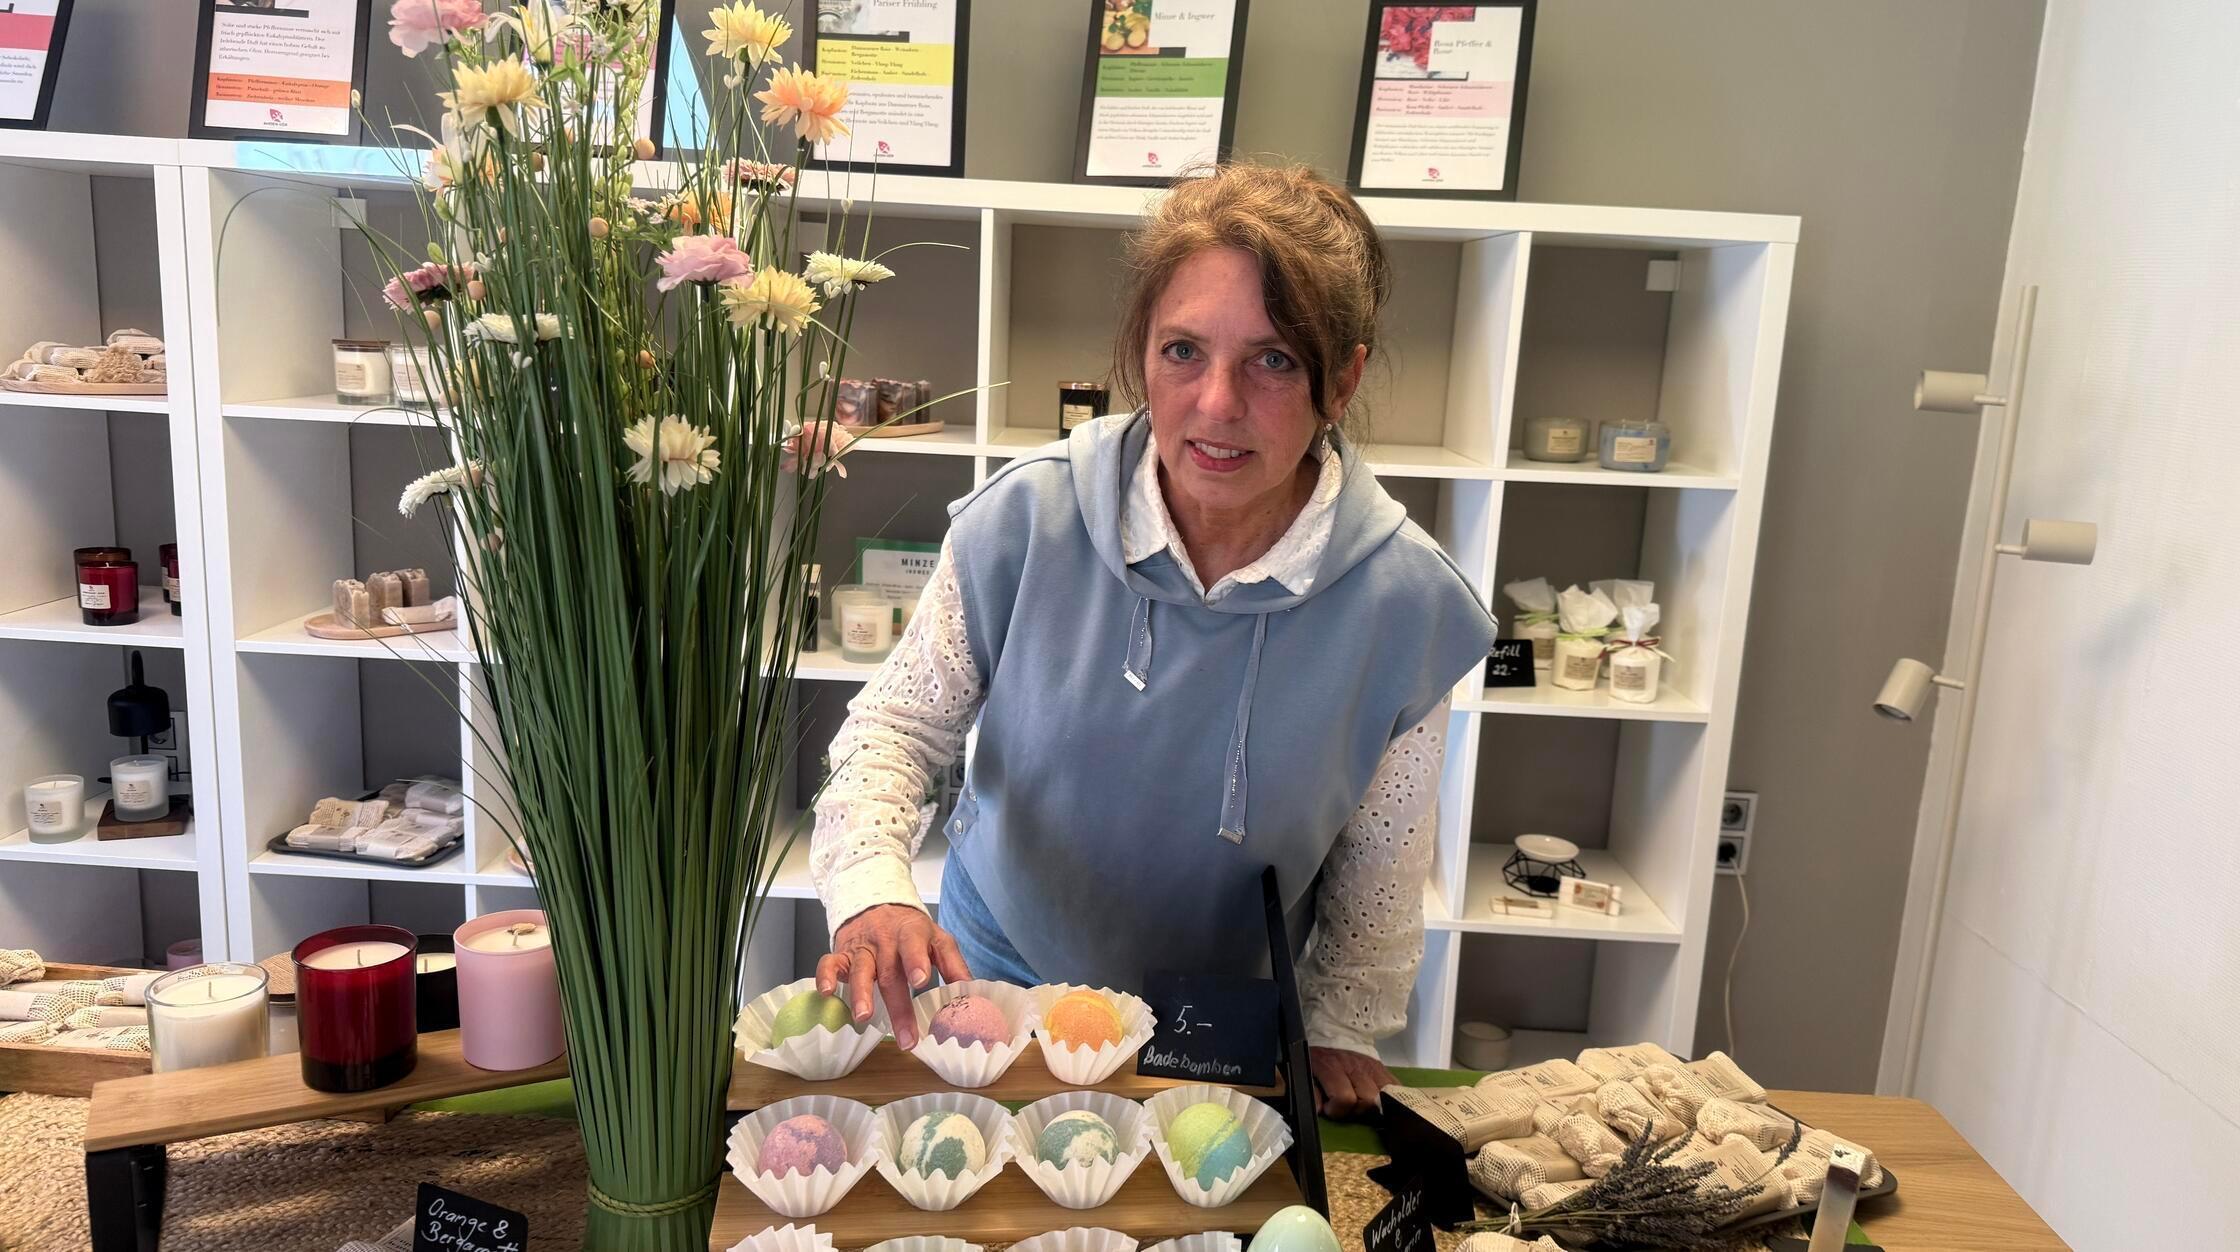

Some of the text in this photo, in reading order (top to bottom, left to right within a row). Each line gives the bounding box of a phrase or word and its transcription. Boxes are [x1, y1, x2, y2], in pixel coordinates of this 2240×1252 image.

[901, 558, 934, 568] MINZE
[428, 1198, 487, 1241] Orange
[493, 1220, 509, 1239] &
[1372, 1190, 1421, 1249] Wacholder
